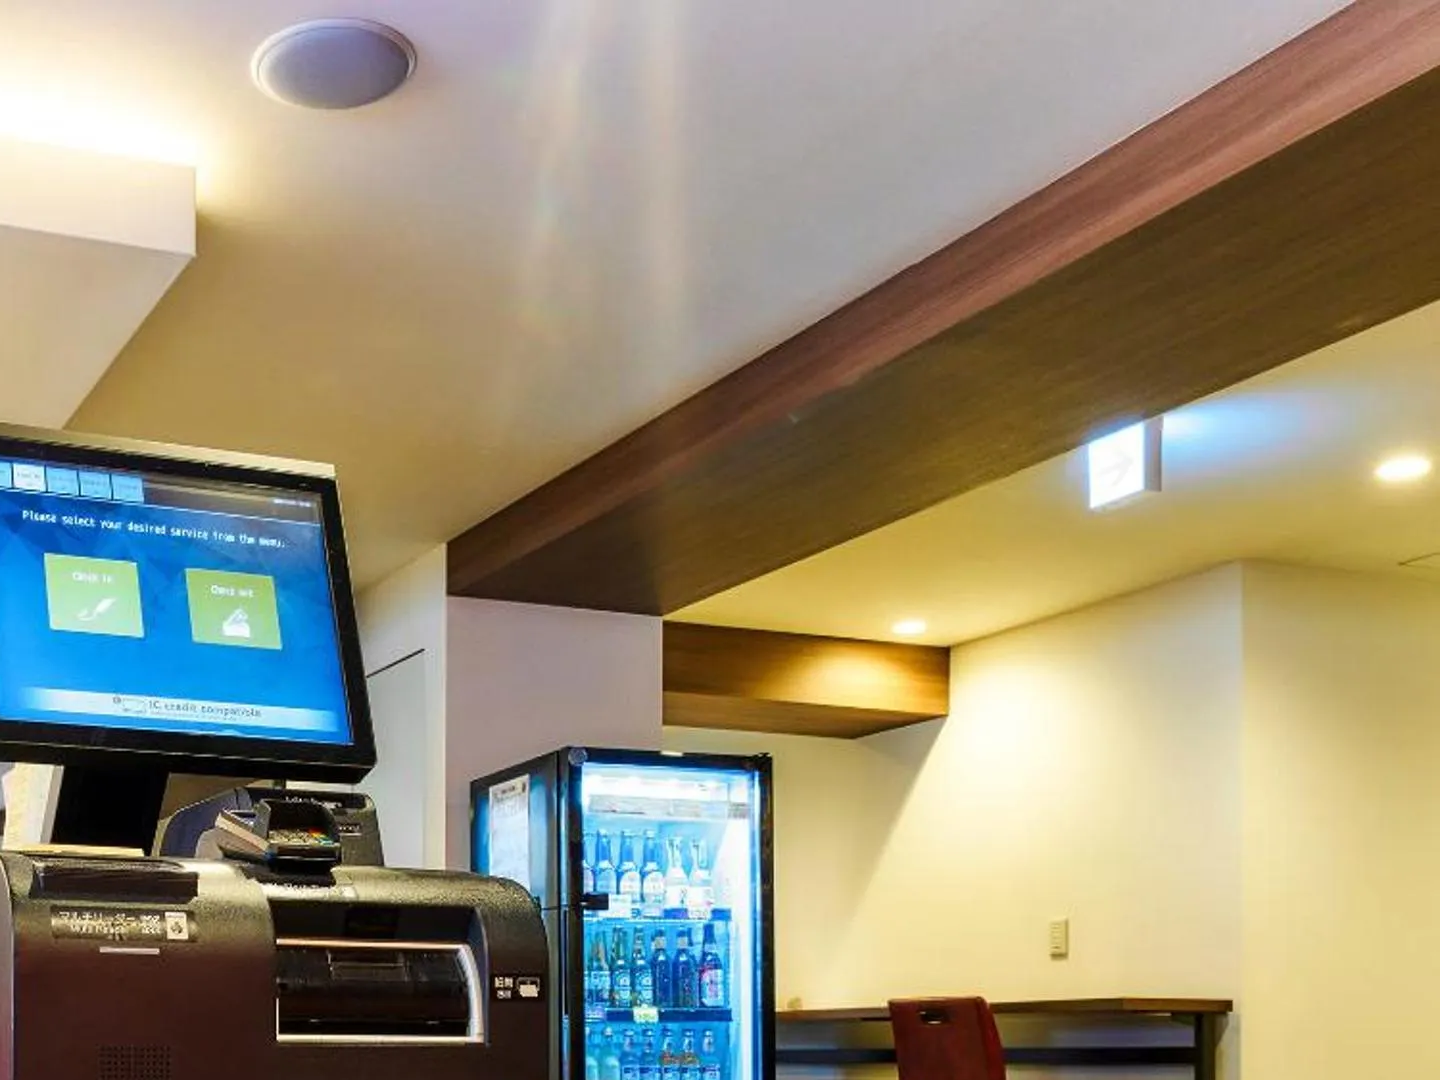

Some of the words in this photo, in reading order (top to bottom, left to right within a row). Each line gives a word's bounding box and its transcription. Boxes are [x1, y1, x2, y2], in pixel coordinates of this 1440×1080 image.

[22, 509, 57, 523] Please
[62, 515, 96, 528] select
[100, 519, 122, 530] your
[127, 521, 166, 535] desired
[170, 526, 209, 541] service
